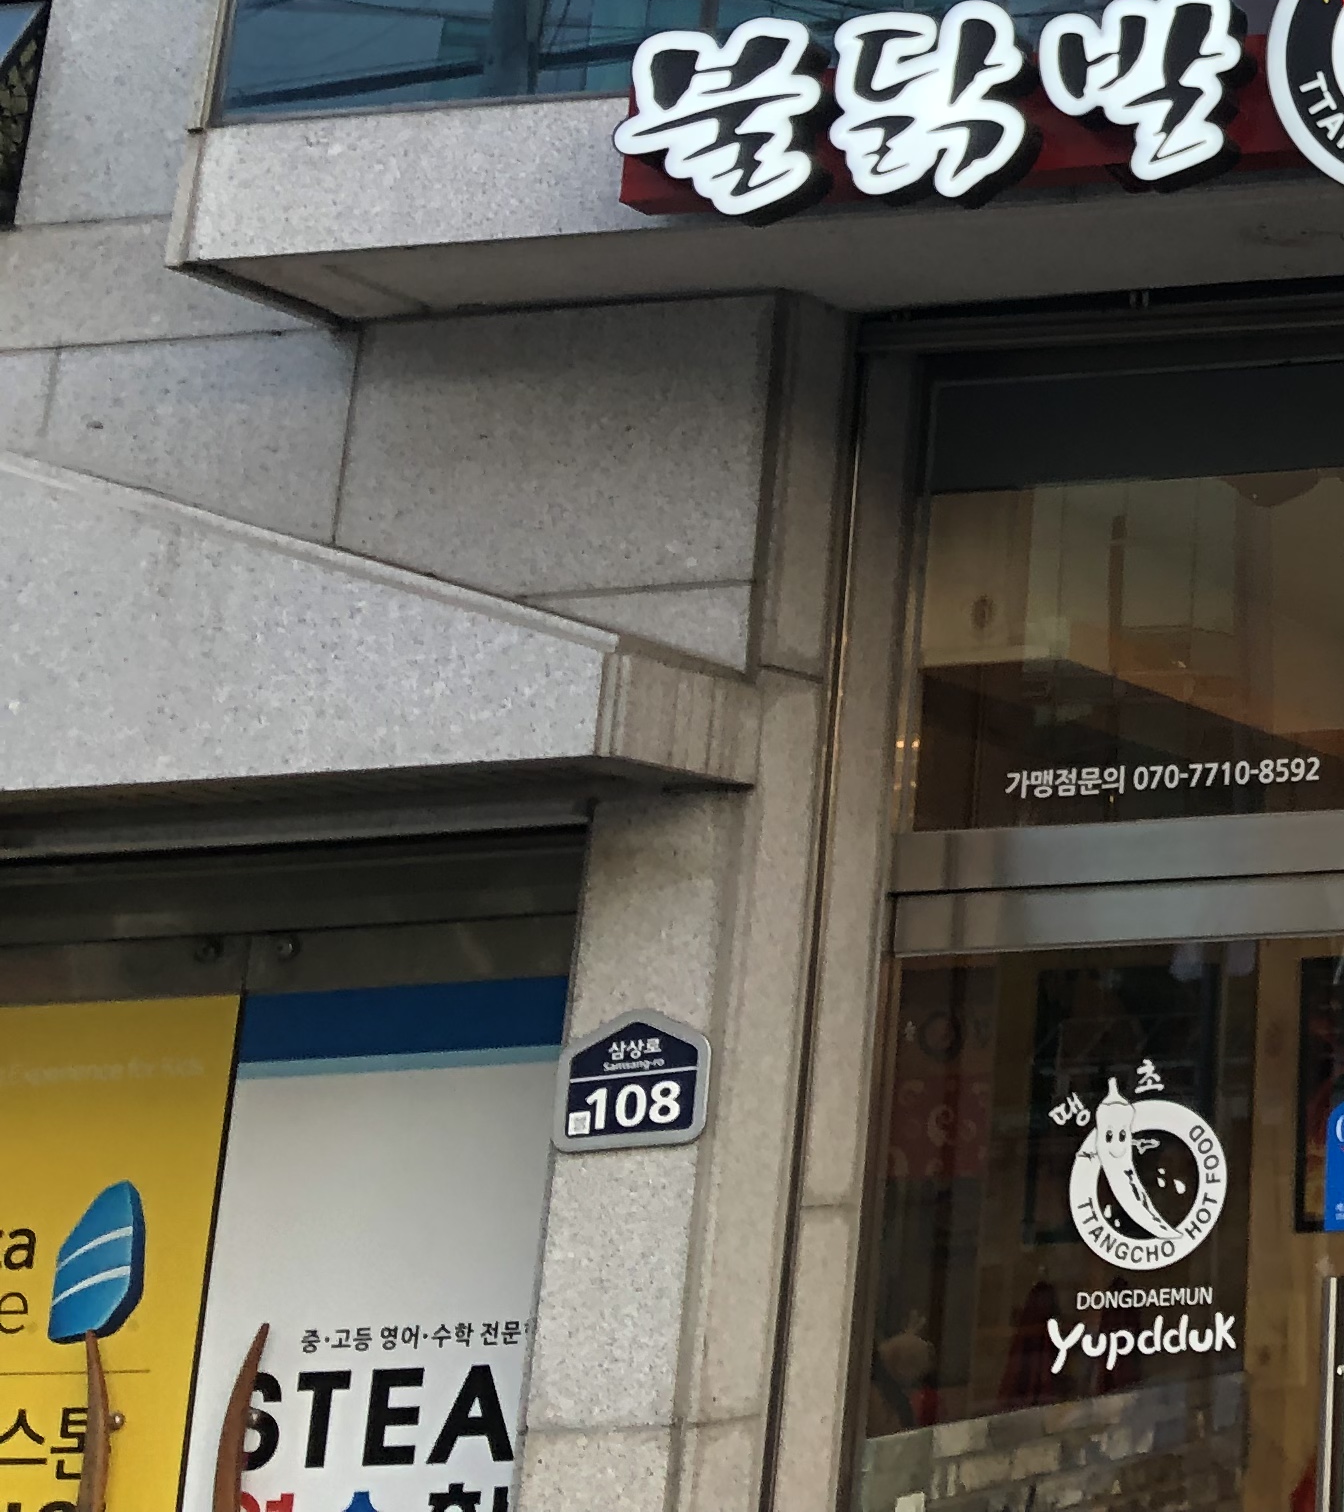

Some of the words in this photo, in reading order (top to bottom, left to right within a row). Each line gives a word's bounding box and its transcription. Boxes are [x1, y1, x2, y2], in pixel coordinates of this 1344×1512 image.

[1004, 765, 1127, 800] 가맹점문의
[1132, 756, 1321, 791] 070-7710-8592
[608, 1037, 663, 1061] 삼상로
[584, 1078, 683, 1131] 108
[1189, 1123, 1222, 1185] FOOD
[1077, 1197, 1177, 1264] TTANGCHO
[1186, 1193, 1219, 1242] HOT
[1076, 1286, 1214, 1311] DONGDAEMUN
[480, 1320, 530, 1347] 전문
[1046, 1312, 1237, 1375] Yupdduk
